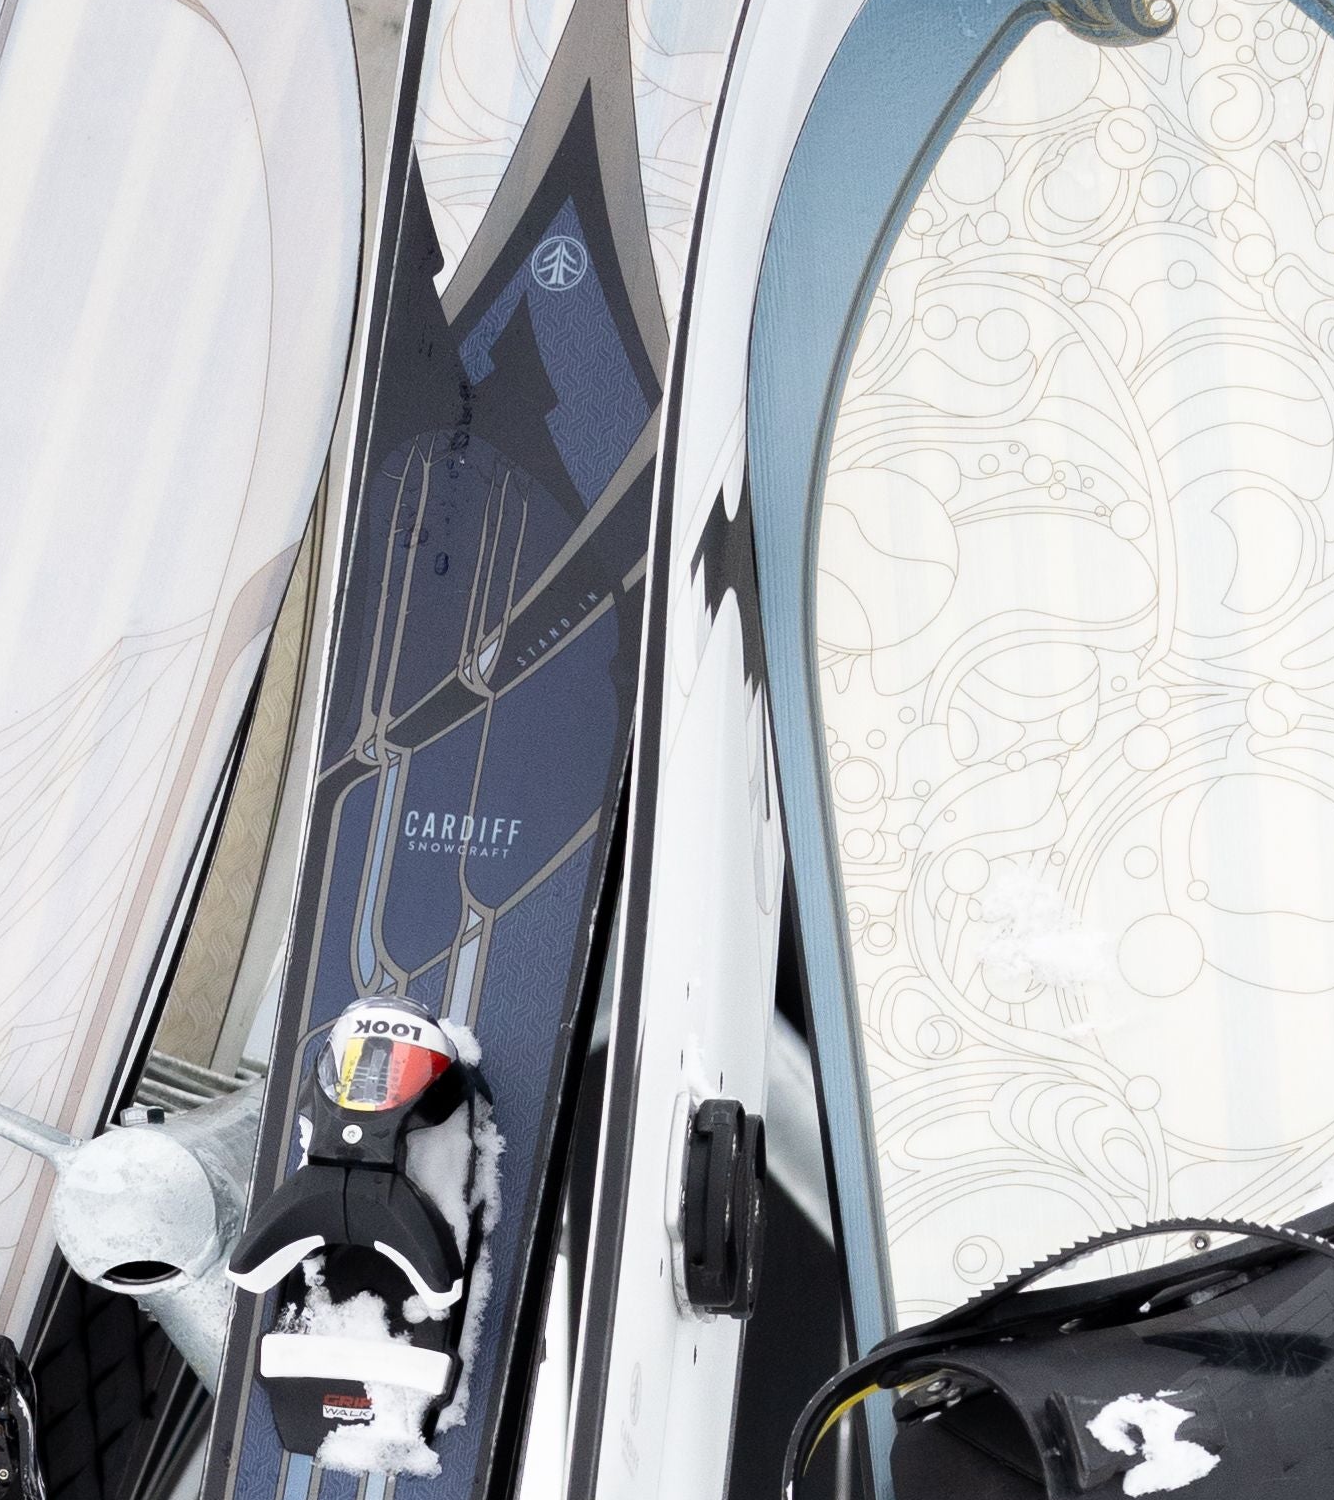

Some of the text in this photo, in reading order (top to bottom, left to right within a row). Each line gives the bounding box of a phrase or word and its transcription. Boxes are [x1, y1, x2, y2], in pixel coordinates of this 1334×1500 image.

[516, 590, 599, 667] STAND IN
[403, 809, 523, 846] CARDIFF
[407, 840, 510, 860] SNOWCRAFT
[354, 1019, 423, 1042] LOOK
[322, 1393, 372, 1409] GRIP
[323, 1406, 371, 1418] WALK
